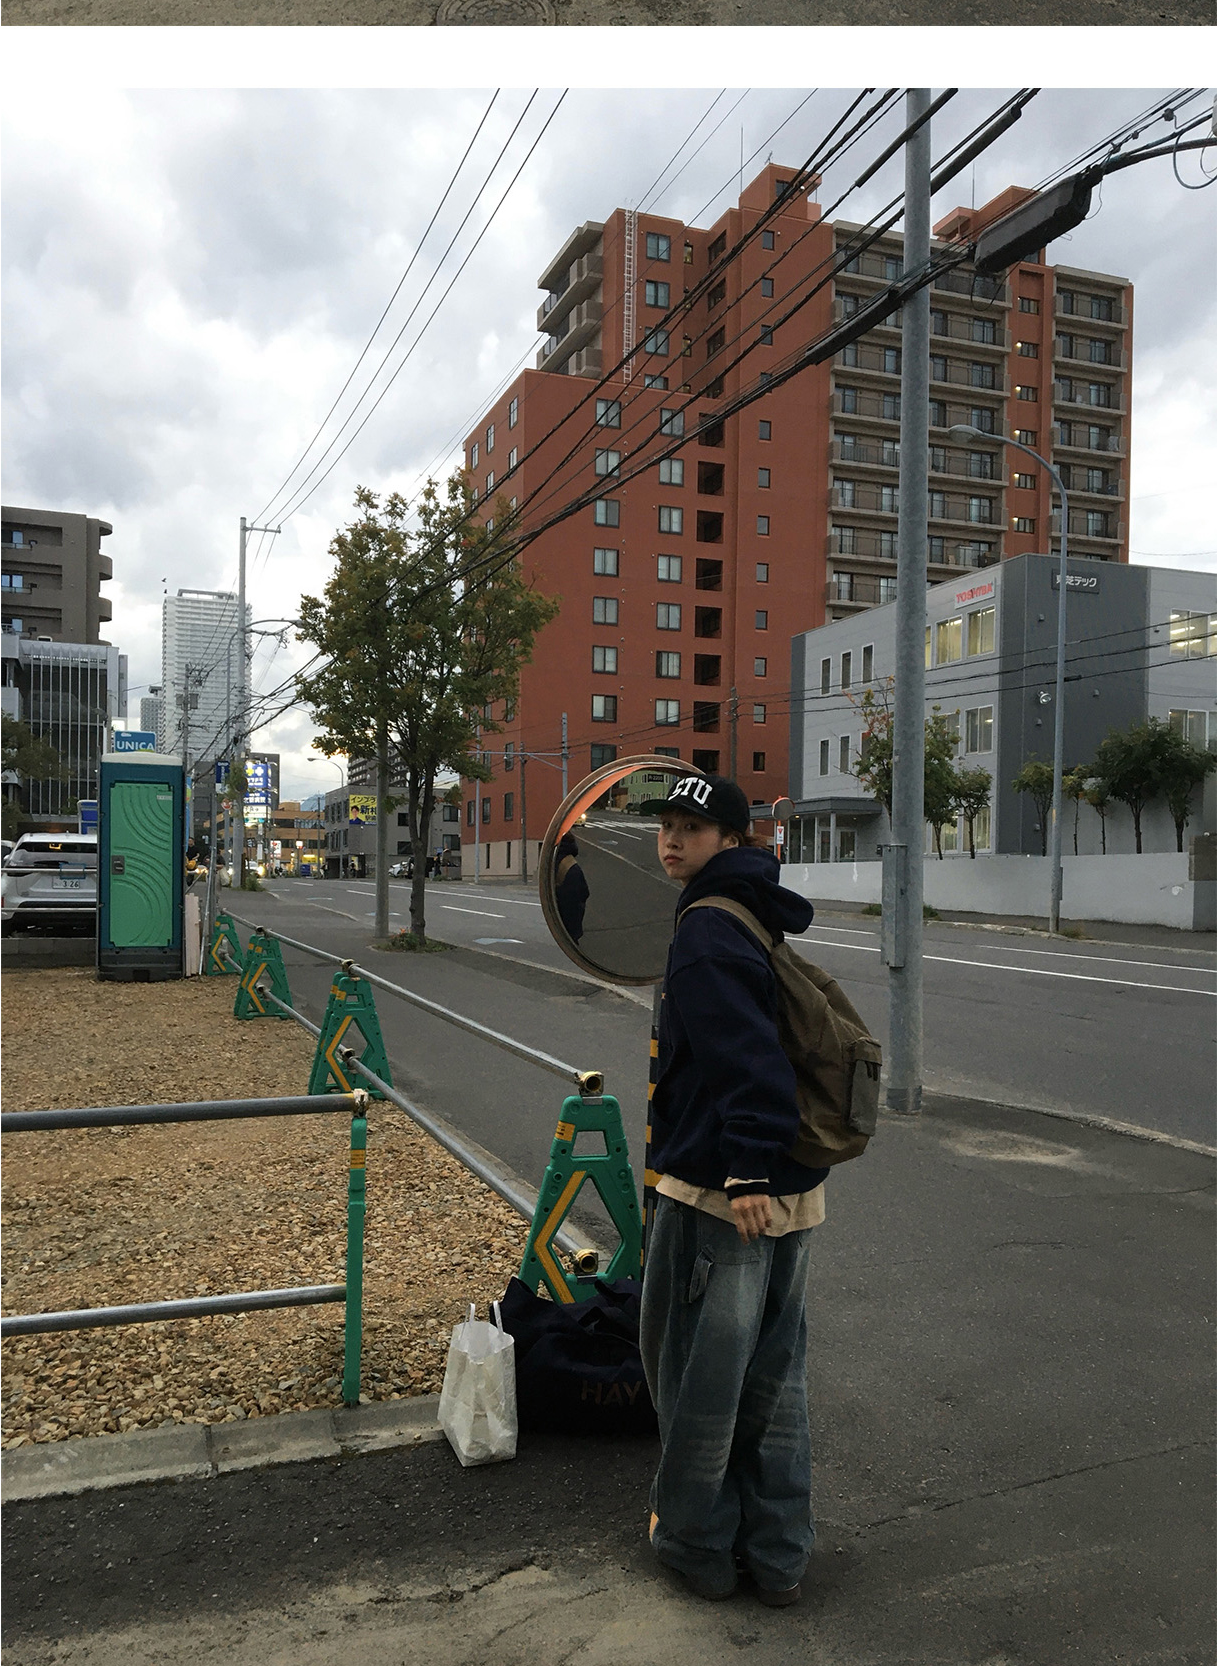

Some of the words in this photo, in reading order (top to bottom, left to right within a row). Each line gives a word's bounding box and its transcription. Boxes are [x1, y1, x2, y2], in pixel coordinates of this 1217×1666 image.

[955, 583, 993, 604] TOSHIBA
[116, 740, 155, 751] UNICA
[667, 776, 713, 805] STU
[581, 1379, 643, 1406] HAY
